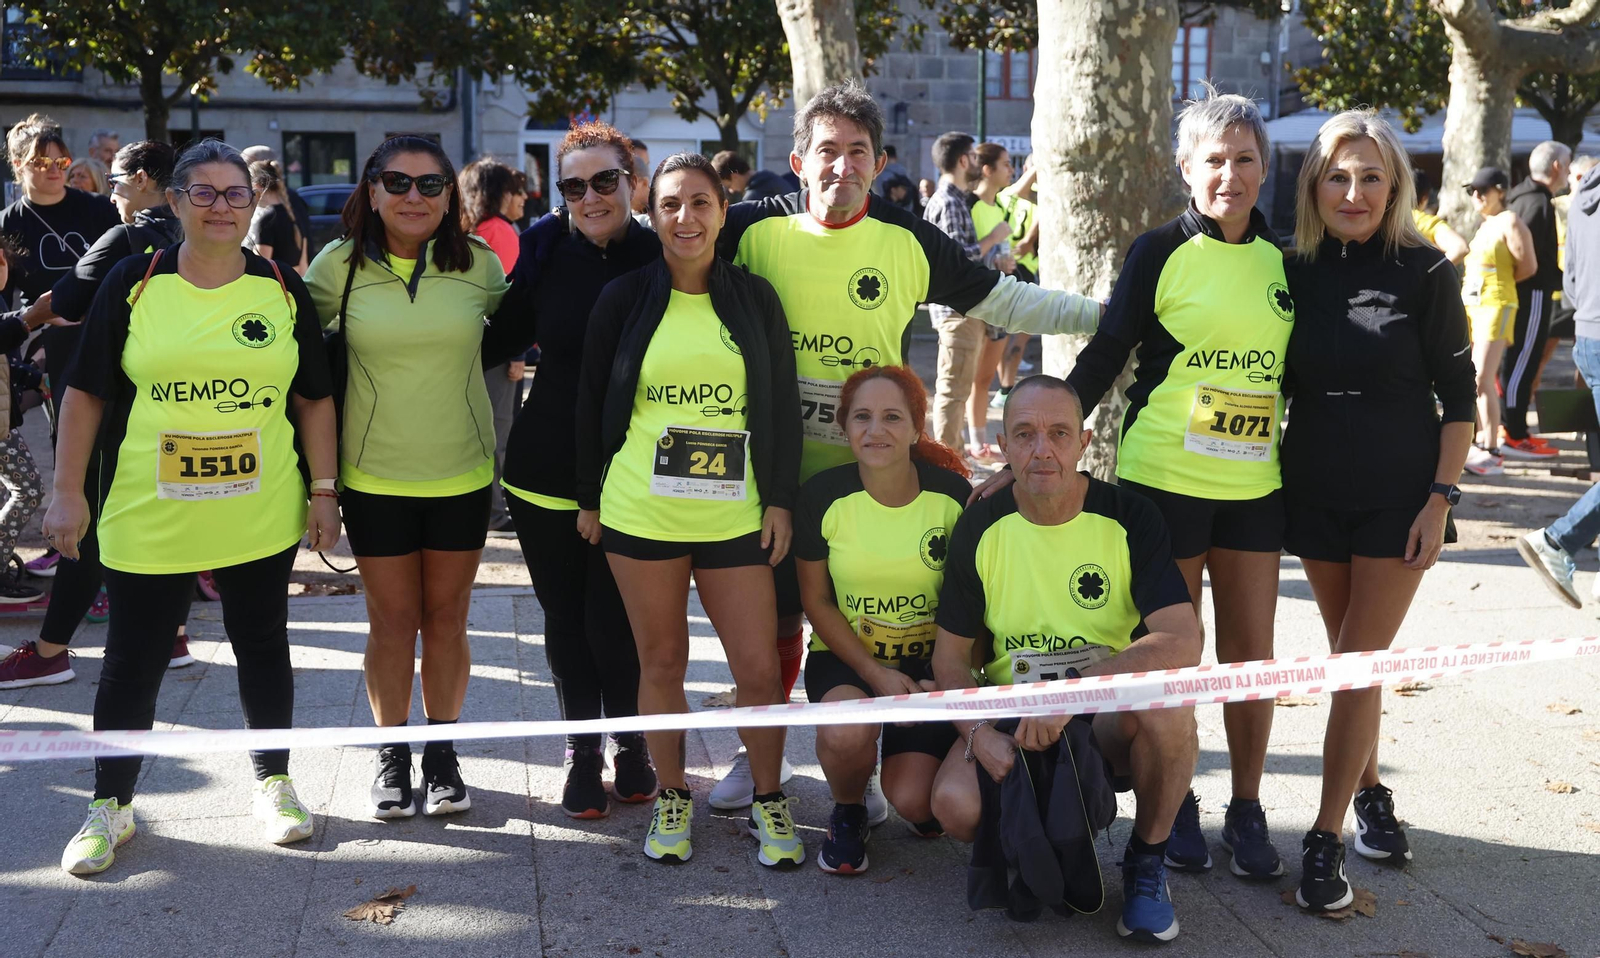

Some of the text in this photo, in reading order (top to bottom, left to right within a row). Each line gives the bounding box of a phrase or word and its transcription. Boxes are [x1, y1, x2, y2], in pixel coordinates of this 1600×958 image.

[790, 330, 853, 354] EMPO
[1186, 350, 1276, 370] AVEMPO
[151, 378, 250, 402] AVEMPO
[646, 383, 733, 405] AVEMPO
[1209, 410, 1271, 437] 1071
[180, 452, 257, 478] 1510
[689, 450, 727, 476] 24
[846, 593, 926, 614] AVEMPO
[1005, 633, 1088, 652] AVEMPO
